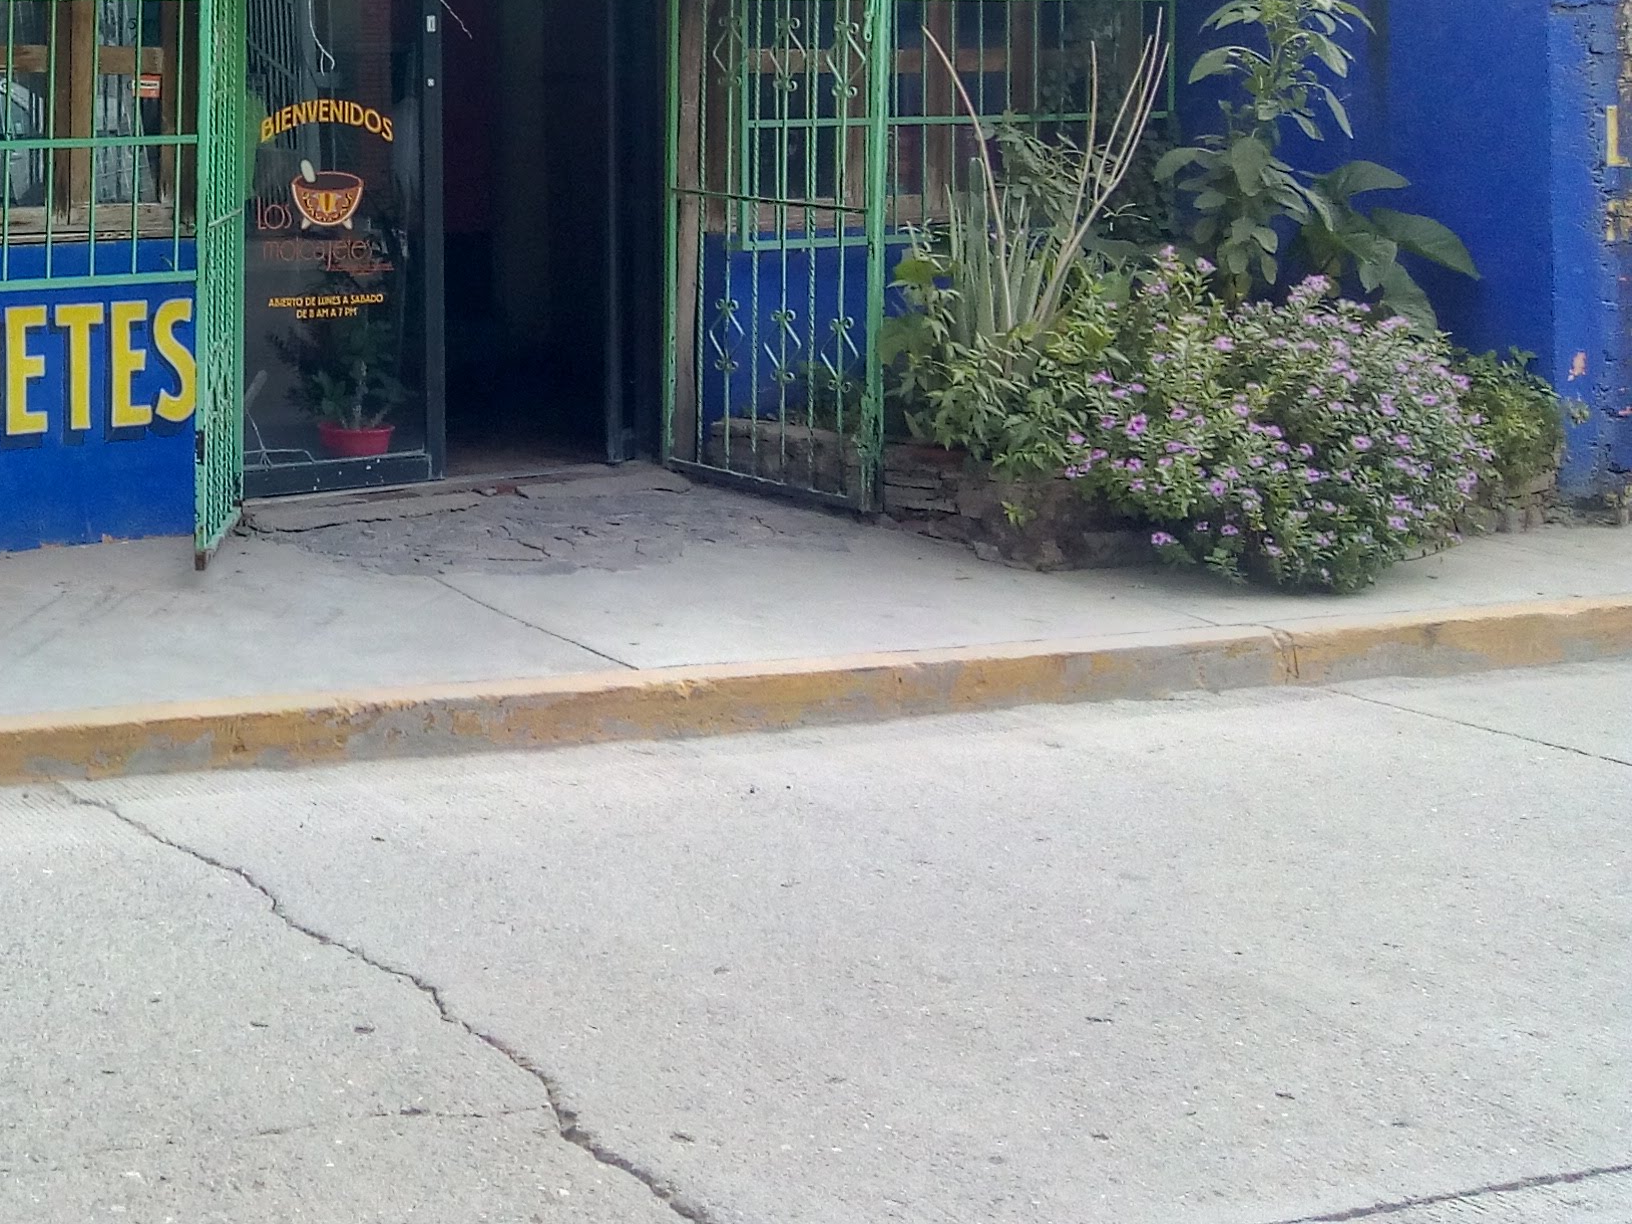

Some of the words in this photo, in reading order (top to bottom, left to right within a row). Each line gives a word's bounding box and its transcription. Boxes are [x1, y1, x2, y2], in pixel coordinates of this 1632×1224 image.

[260, 98, 394, 144] BIENVENIDOS
[268, 297, 304, 308] ABIERTO
[305, 296, 316, 307] DE
[318, 295, 341, 306] LUNES
[342, 295, 350, 305] A
[350, 293, 384, 305] SABADO
[296, 309, 308, 319] DE
[316, 308, 330, 318] AM
[330, 307, 337, 317] A
[338, 307, 344, 317] 7
[344, 306, 359, 317] PM
